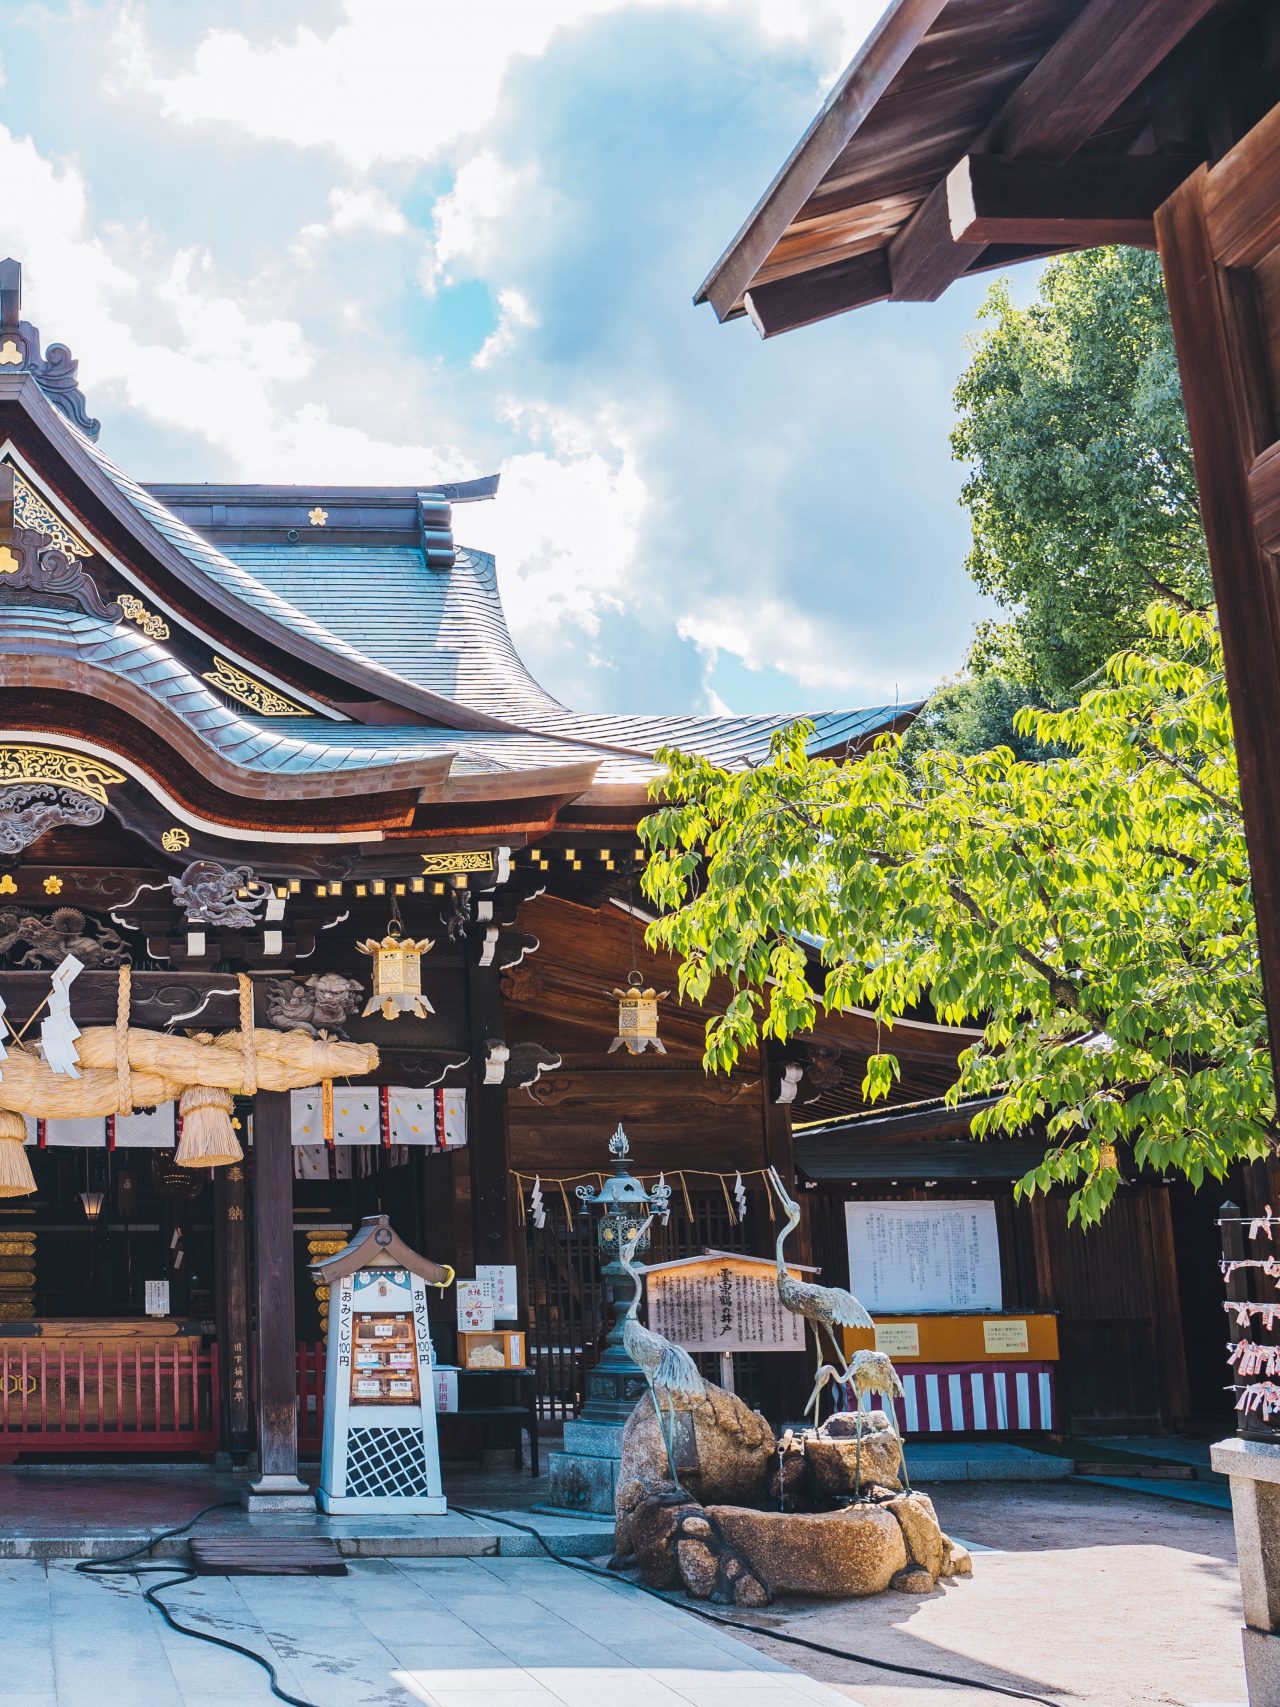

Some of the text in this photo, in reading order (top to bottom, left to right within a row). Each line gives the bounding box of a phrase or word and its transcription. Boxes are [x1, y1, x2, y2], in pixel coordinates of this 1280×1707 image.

[227, 1166, 244, 1221] 奉納
[339, 1291, 352, 1367] おみくじ100円
[414, 1290, 430, 1366] おみくじ100円
